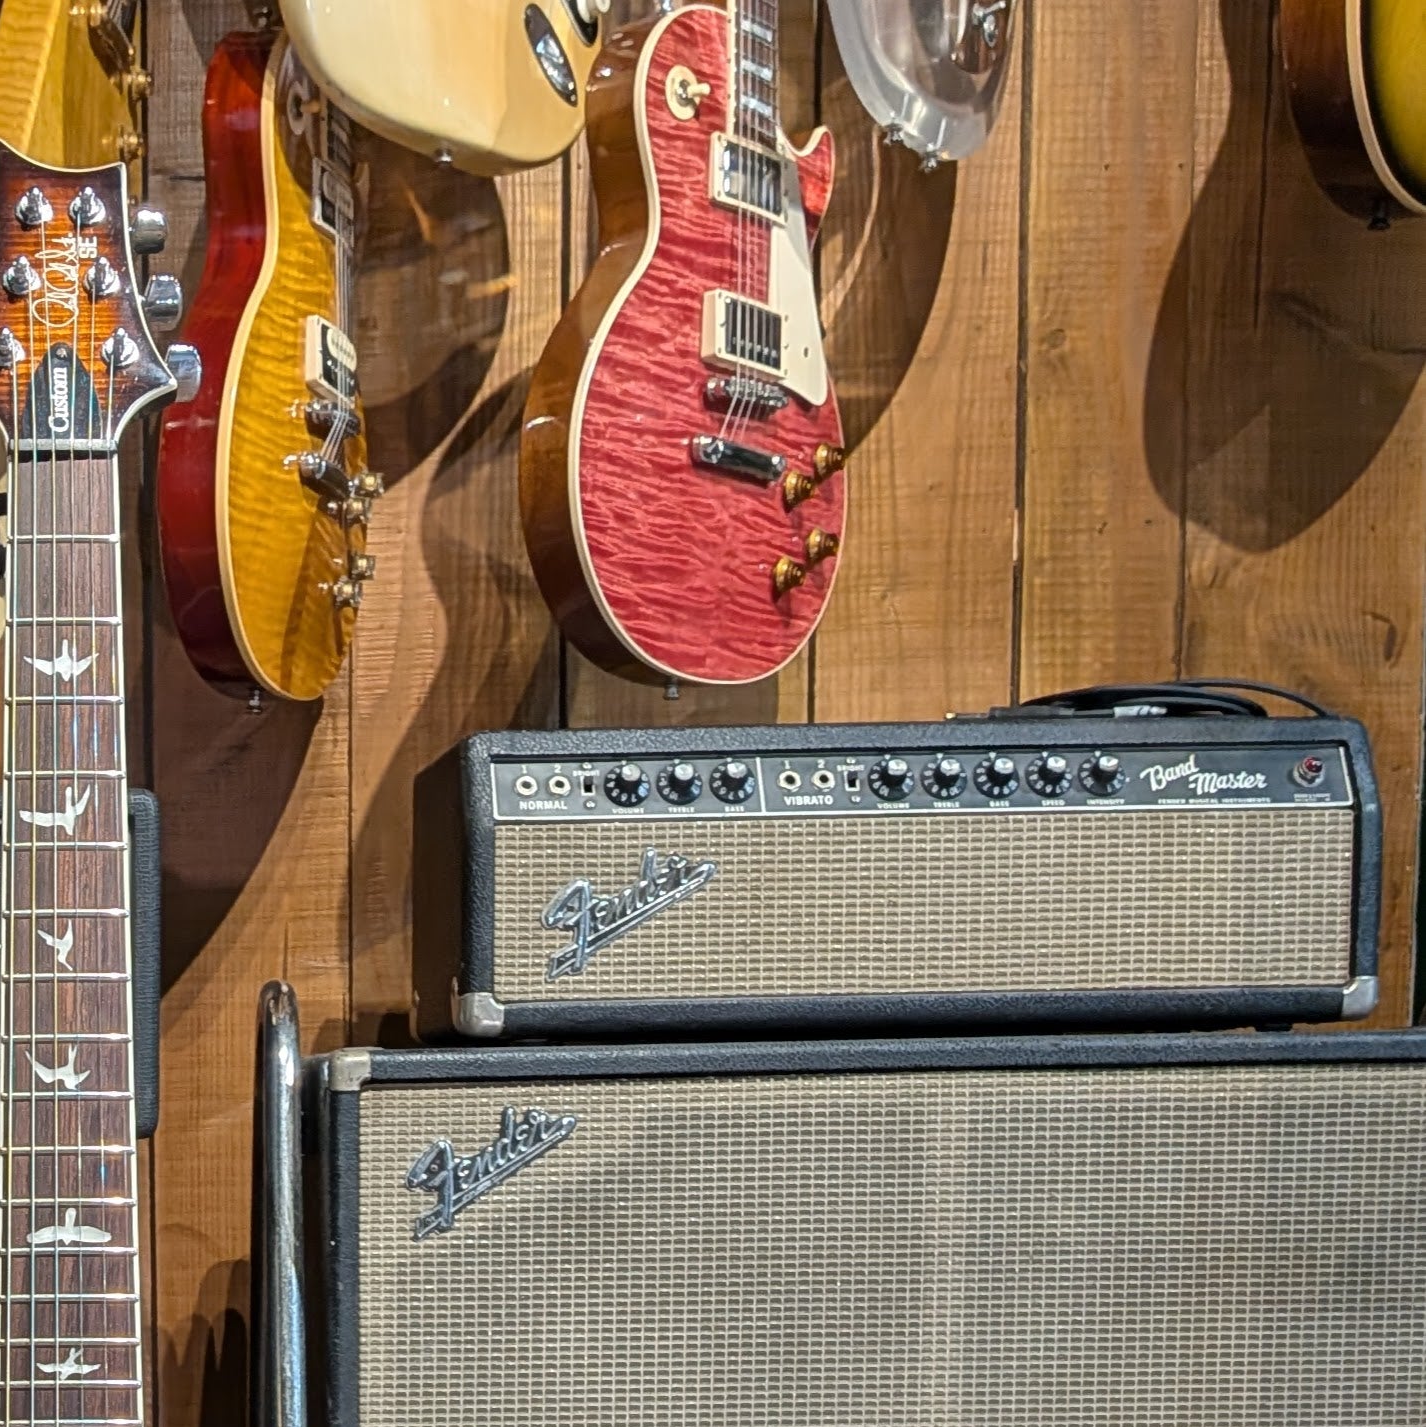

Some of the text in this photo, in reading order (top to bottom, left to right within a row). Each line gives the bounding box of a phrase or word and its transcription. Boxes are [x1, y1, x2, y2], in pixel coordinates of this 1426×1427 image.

[77, 235, 98, 259] SE
[48, 367, 69, 432] Custom
[553, 764, 561, 774] 2
[817, 759, 825, 769] 2
[1139, 753, 1200, 791] Band
[1187, 770, 1268, 795] Master
[519, 800, 568, 811] NORMAL
[783, 795, 834, 806] VIBRATO
[989, 800, 1010, 808] BASS
[612, 807, 645, 815] VOLUME
[724, 805, 745, 813] BASS
[541, 846, 718, 982] Fender
[405, 1104, 576, 1242] Fender
